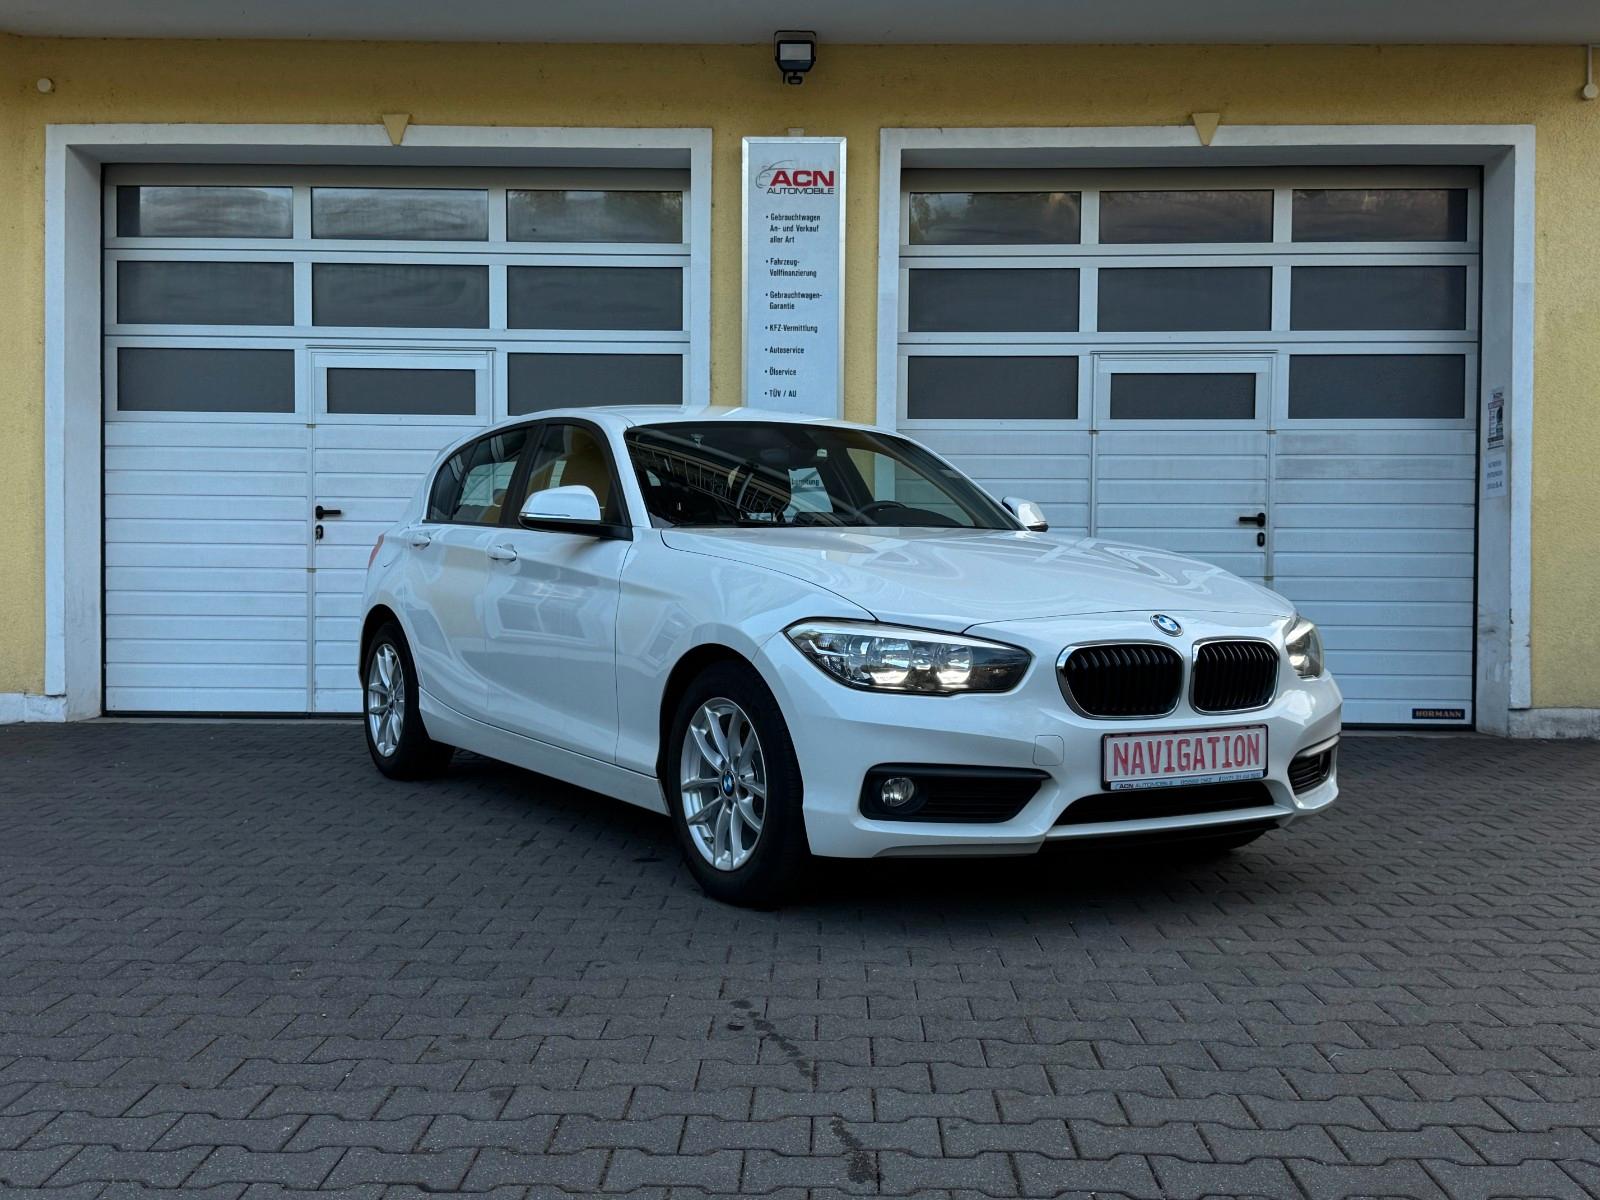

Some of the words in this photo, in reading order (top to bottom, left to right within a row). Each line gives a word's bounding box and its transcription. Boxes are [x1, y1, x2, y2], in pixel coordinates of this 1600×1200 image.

[770, 171, 834, 187] ACN
[766, 187, 834, 195] AUTOMOBILE
[770, 213, 821, 222] Gebrauchtwagen
[770, 224, 781, 232] An-
[782, 224, 794, 232] und
[796, 224, 819, 232] Verkauf
[770, 236, 783, 244] aller
[785, 236, 795, 244] Art
[770, 258, 800, 267] Fahrzeug-
[769, 269, 817, 278] Vollfinanzierung
[769, 291, 823, 300] Gebrauchtwagen-
[769, 302, 795, 310] Garantie
[769, 324, 818, 334] KFZ-Vermittlung
[769, 346, 805, 354] Autoservice
[769, 367, 797, 376] Ölservice
[769, 389, 781, 398] TÜV
[788, 390, 797, 398] AU
[1113, 733, 1260, 777] NAVIGATION
